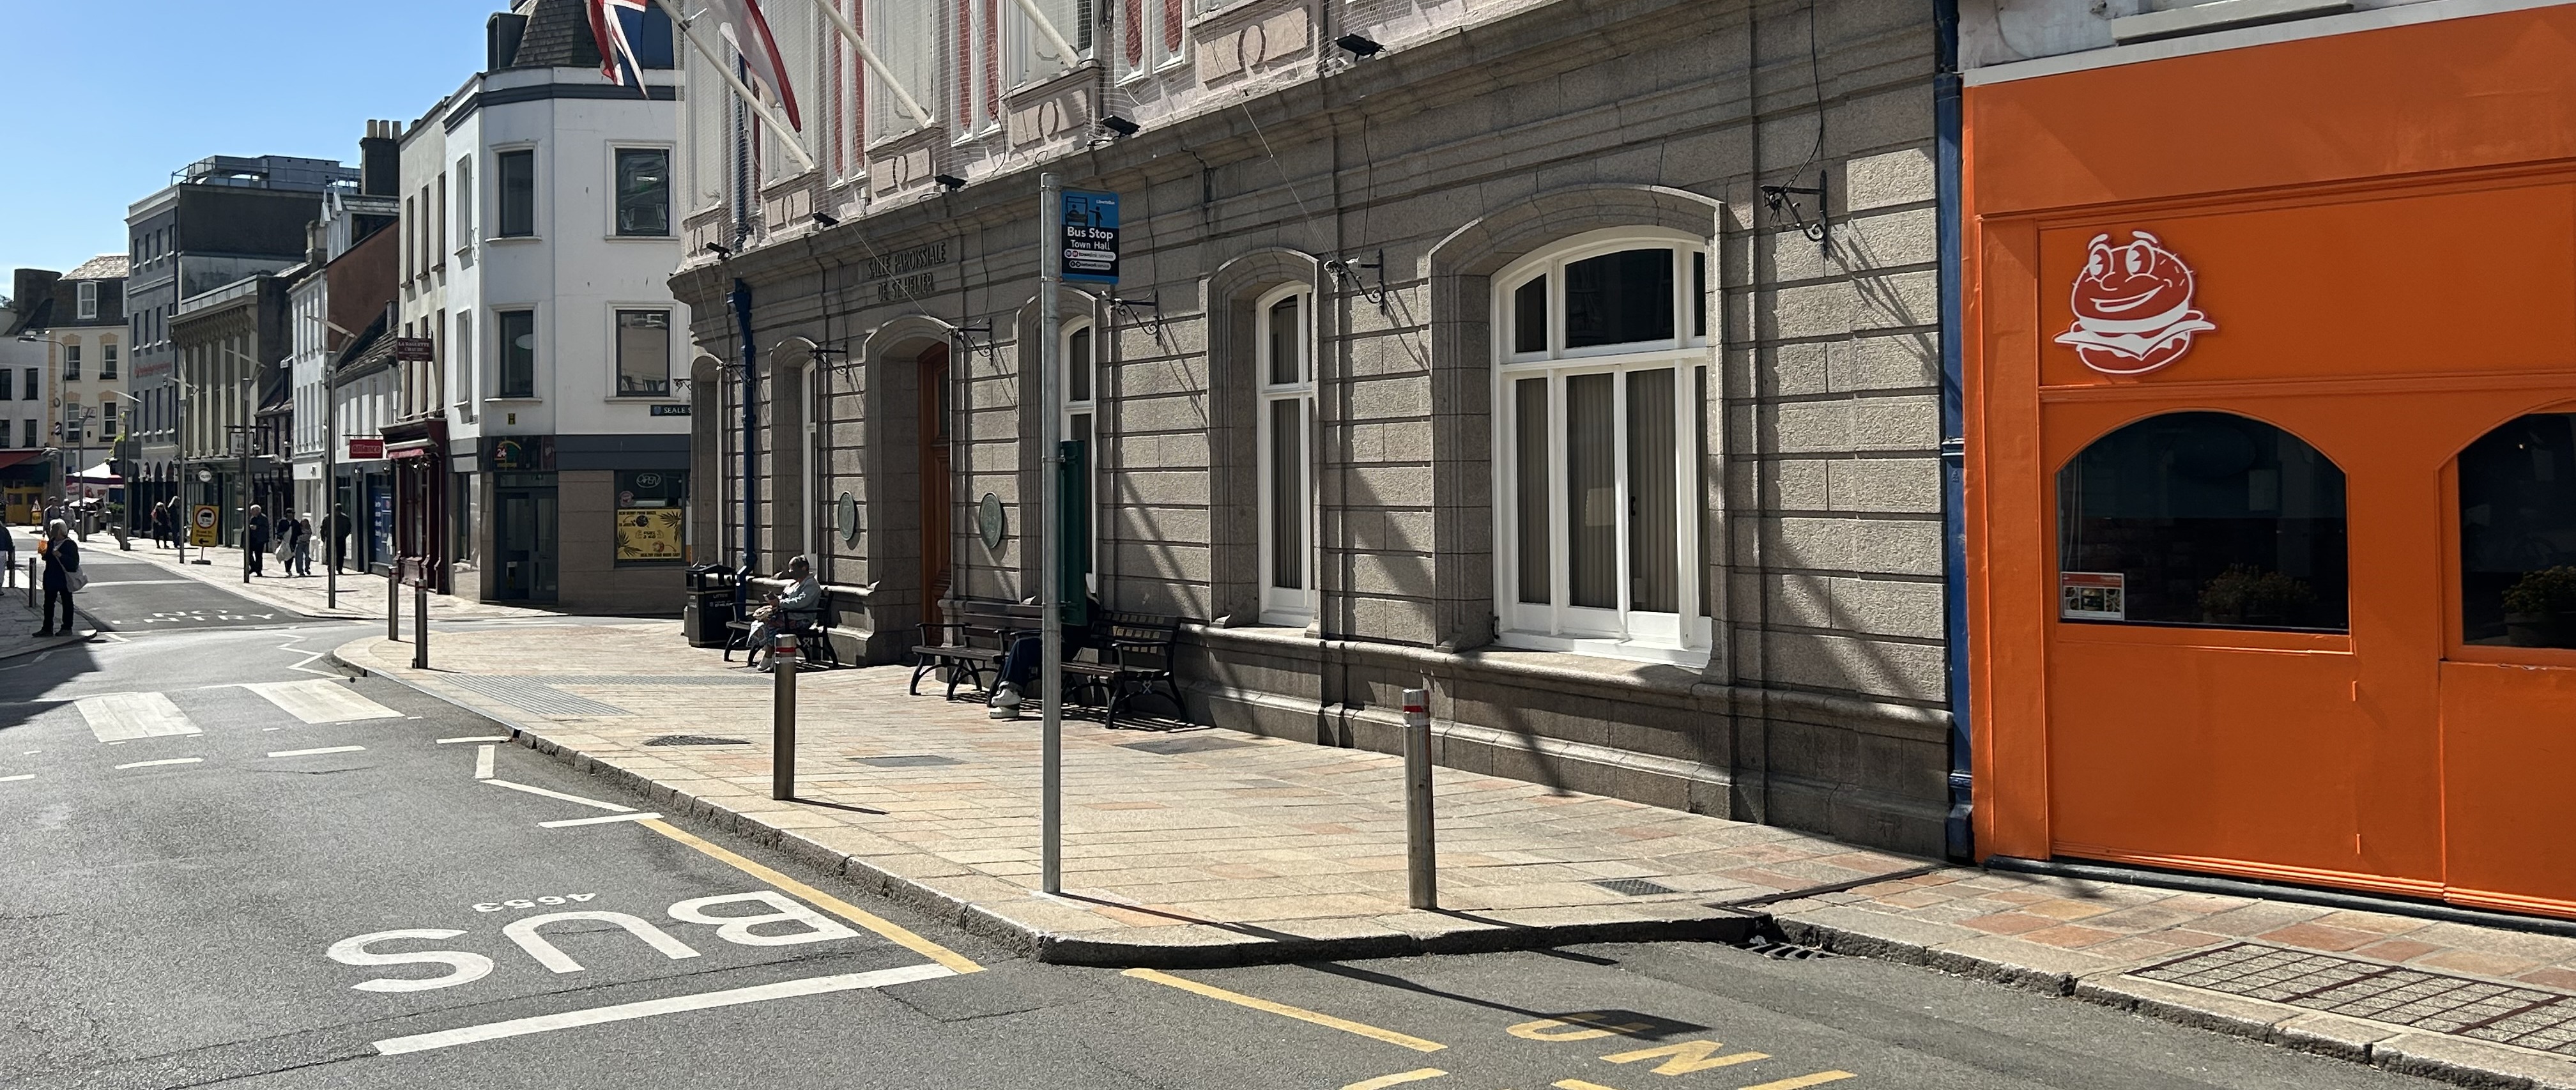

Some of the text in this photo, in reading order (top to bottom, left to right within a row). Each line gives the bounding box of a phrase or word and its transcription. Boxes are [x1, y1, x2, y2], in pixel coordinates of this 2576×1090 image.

[1067, 226, 1114, 242] Bus Stop
[1070, 240, 1110, 250] Town Hall
[868, 242, 946, 279] SALLE PAROISSIALE
[878, 282, 887, 302] DE
[903, 273, 934, 296] HELIER
[351, 444, 381, 454] Alliance
[496, 449, 507, 457] 24
[638, 475, 660, 485] OPEN
[472, 892, 596, 913] 4653
[326, 890, 861, 993] BUS
